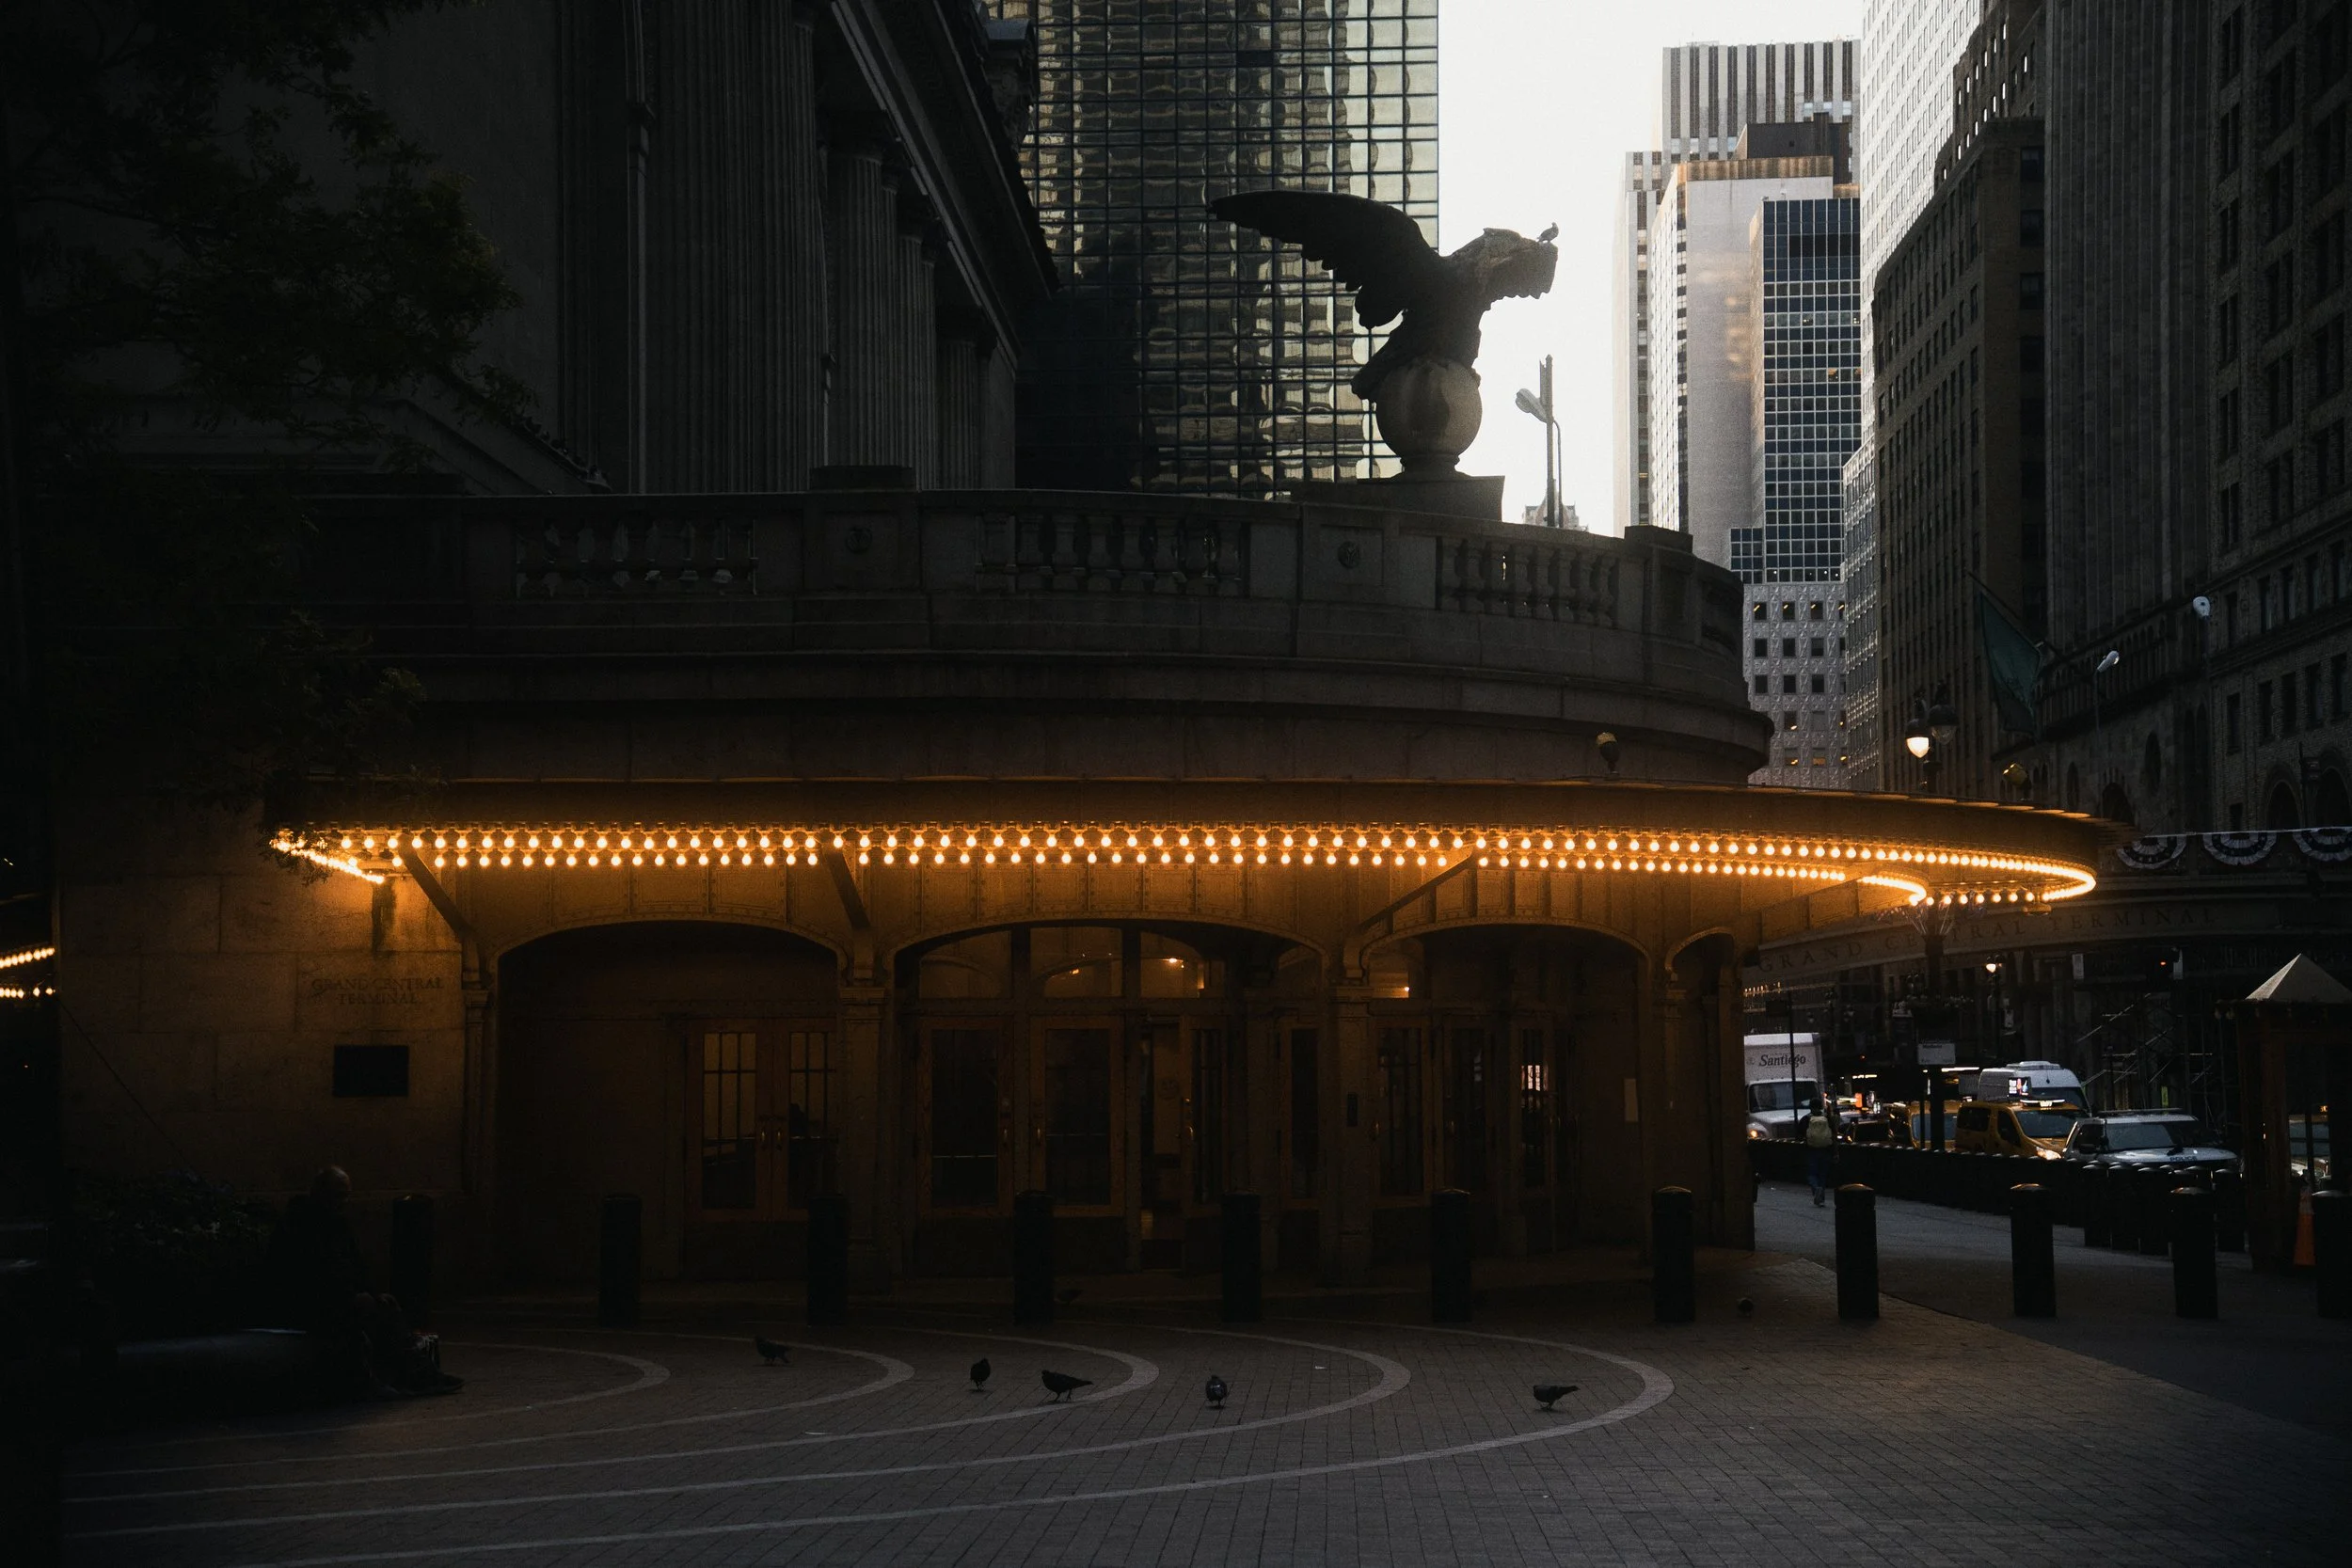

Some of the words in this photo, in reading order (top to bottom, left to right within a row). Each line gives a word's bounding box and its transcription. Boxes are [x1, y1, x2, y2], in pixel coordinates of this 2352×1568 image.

[1759, 942, 1862, 973] GRAND
[1884, 920, 2026, 951] CETRAL
[2049, 909, 2217, 931] TERMINAL
[311, 978, 369, 990] GRAND
[373, 977, 443, 991] CENTRAL
